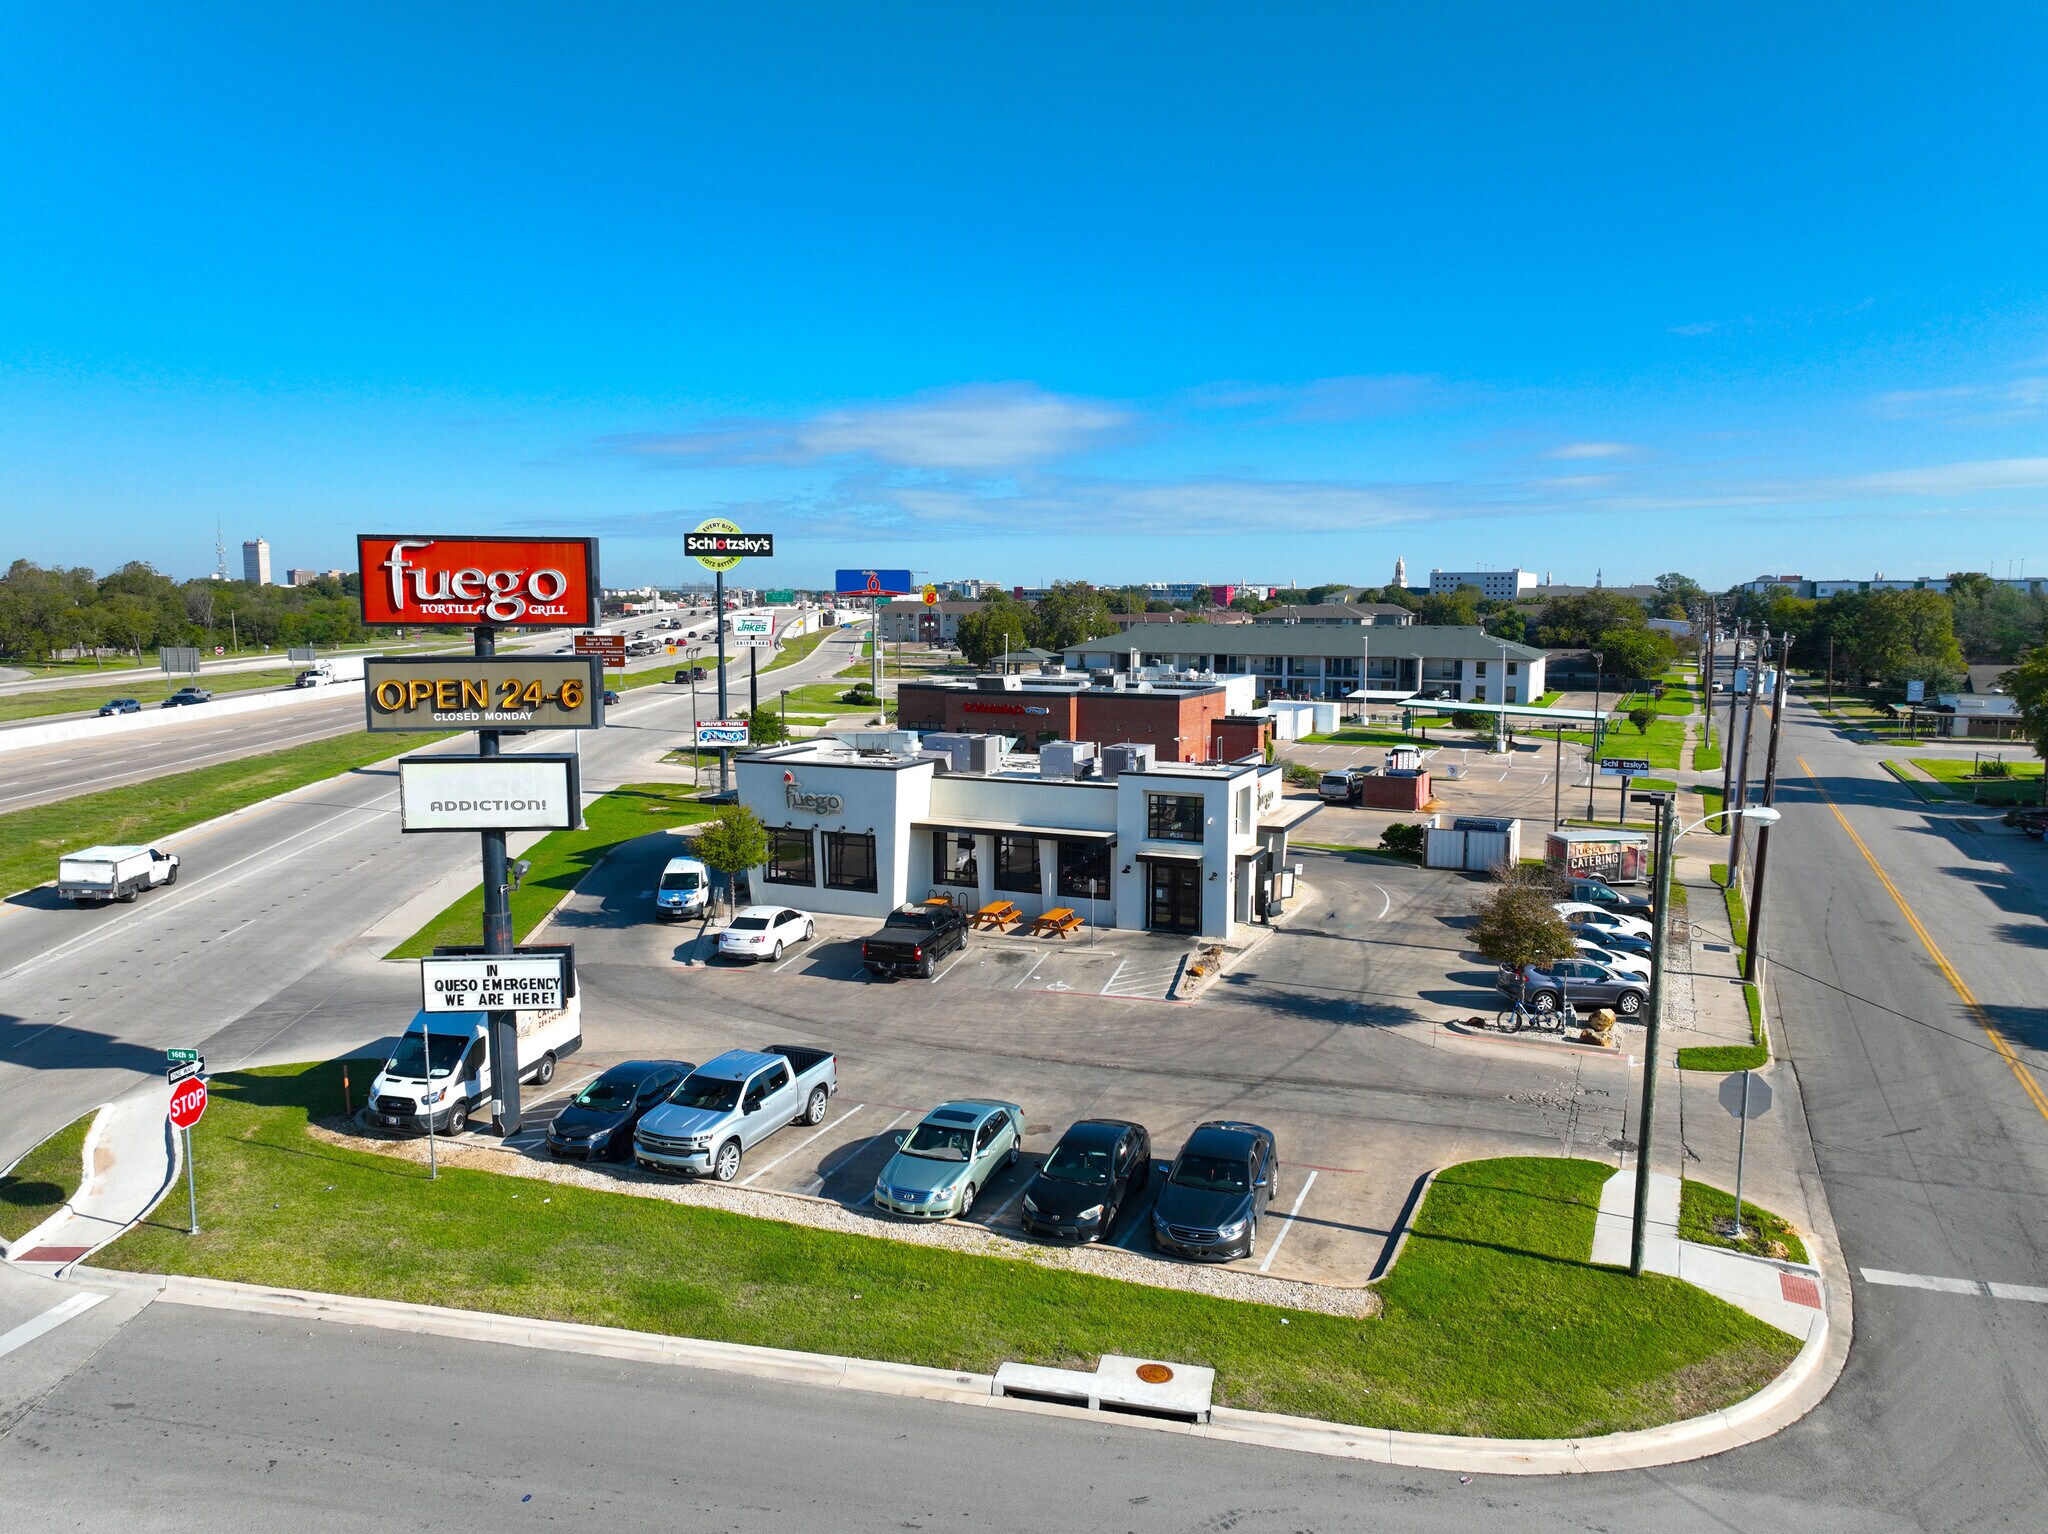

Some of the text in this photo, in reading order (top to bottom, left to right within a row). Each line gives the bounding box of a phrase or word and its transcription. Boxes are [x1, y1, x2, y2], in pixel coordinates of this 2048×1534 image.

[702, 522, 735, 532] EVERY BITE
[687, 537, 770, 553] Schlotzsky's
[702, 556, 736, 567] LOTZ BETTER
[384, 540, 567, 621] fuego
[867, 572, 881, 591] 6
[420, 603, 568, 616] TORTILLA GRILL
[737, 619, 767, 632] Jakes
[376, 678, 584, 710] OPEN 24-6
[434, 712, 533, 722] CLOSED MONDAY
[1602, 759, 1648, 769] Schlotzsky's
[430, 799, 547, 812] ADDICTION!
[1571, 853, 1619, 869] CATERING
[486, 965, 498, 977] IN
[434, 978, 561, 991] QUESO EMERGENCY
[445, 992, 556, 1006] WE ARE HERE!
[171, 1051, 186, 1059] 16th
[172, 1065, 194, 1080] ONE WAY
[172, 1088, 204, 1117] STOP
